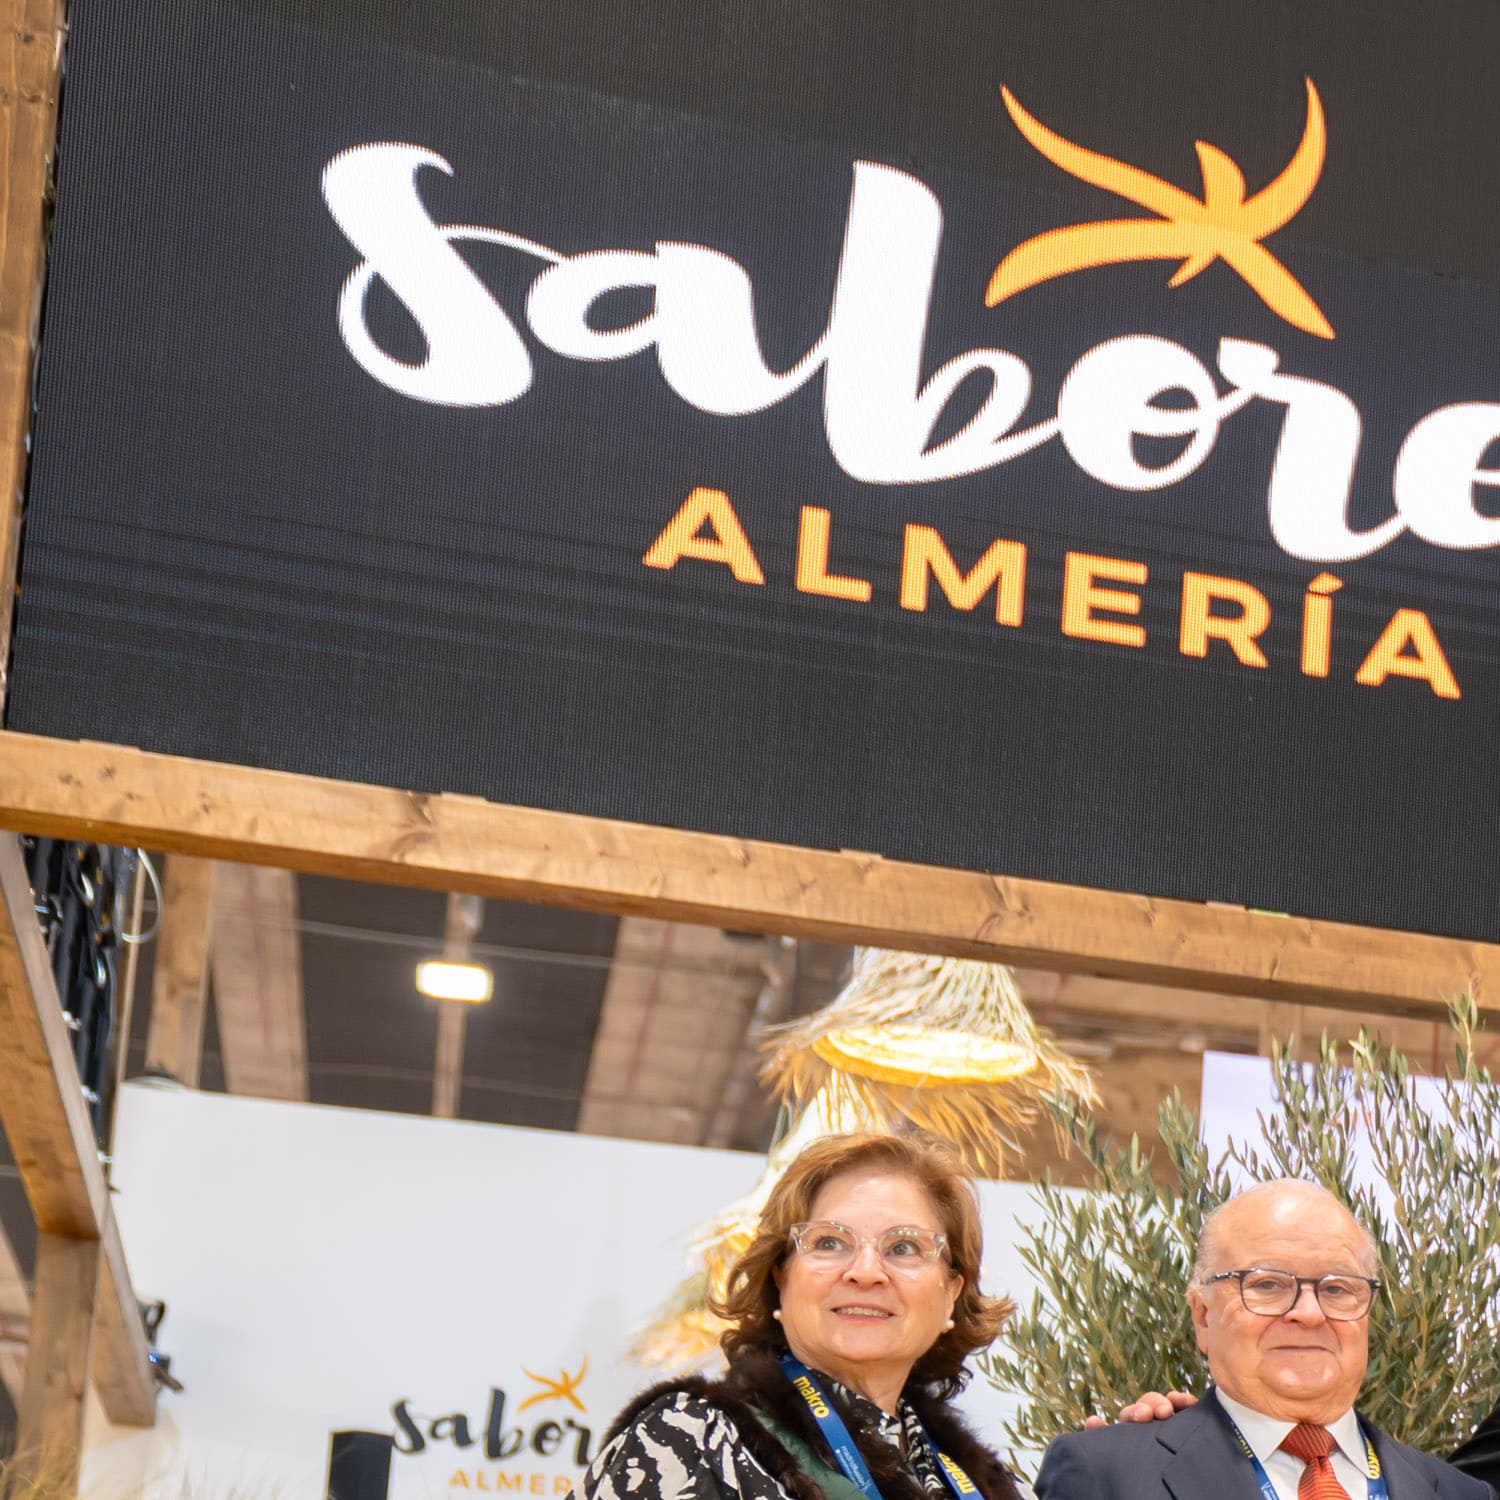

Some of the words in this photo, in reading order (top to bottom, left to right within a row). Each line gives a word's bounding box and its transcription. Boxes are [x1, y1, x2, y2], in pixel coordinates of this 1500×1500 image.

[641, 487, 1462, 700] ALMERÍA
[391, 1384, 598, 1468] Sabor
[793, 1375, 829, 1418] makro
[449, 1467, 574, 1497] ALMER
